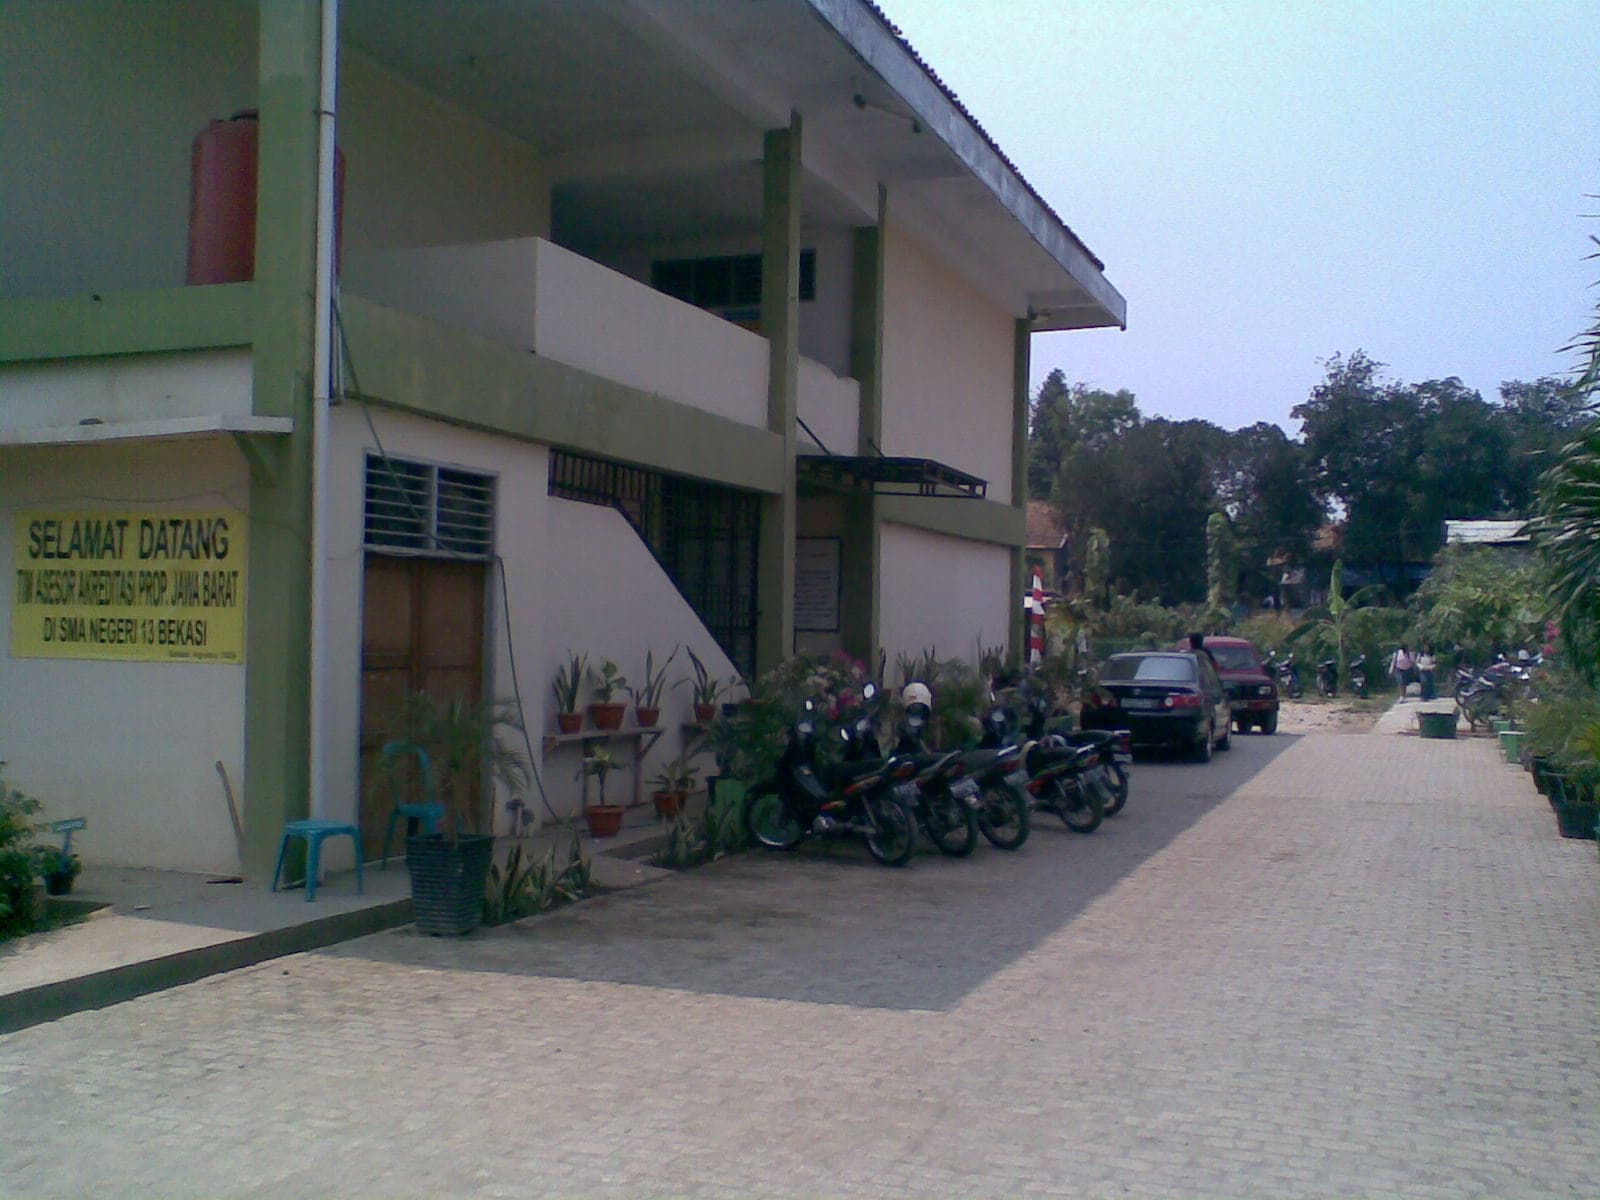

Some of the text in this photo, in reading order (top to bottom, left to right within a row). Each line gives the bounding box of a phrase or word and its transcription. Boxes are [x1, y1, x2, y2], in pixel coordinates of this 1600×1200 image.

[28, 517, 229, 560] SELAMAT DATANG
[36, 569, 76, 606] ASESOR
[79, 570, 136, 606] AKREDITASI
[171, 571, 200, 607] JAWA
[203, 570, 239, 607] BARAT
[44, 616, 207, 646] DI SMA NEGERI 13 BEKASI
